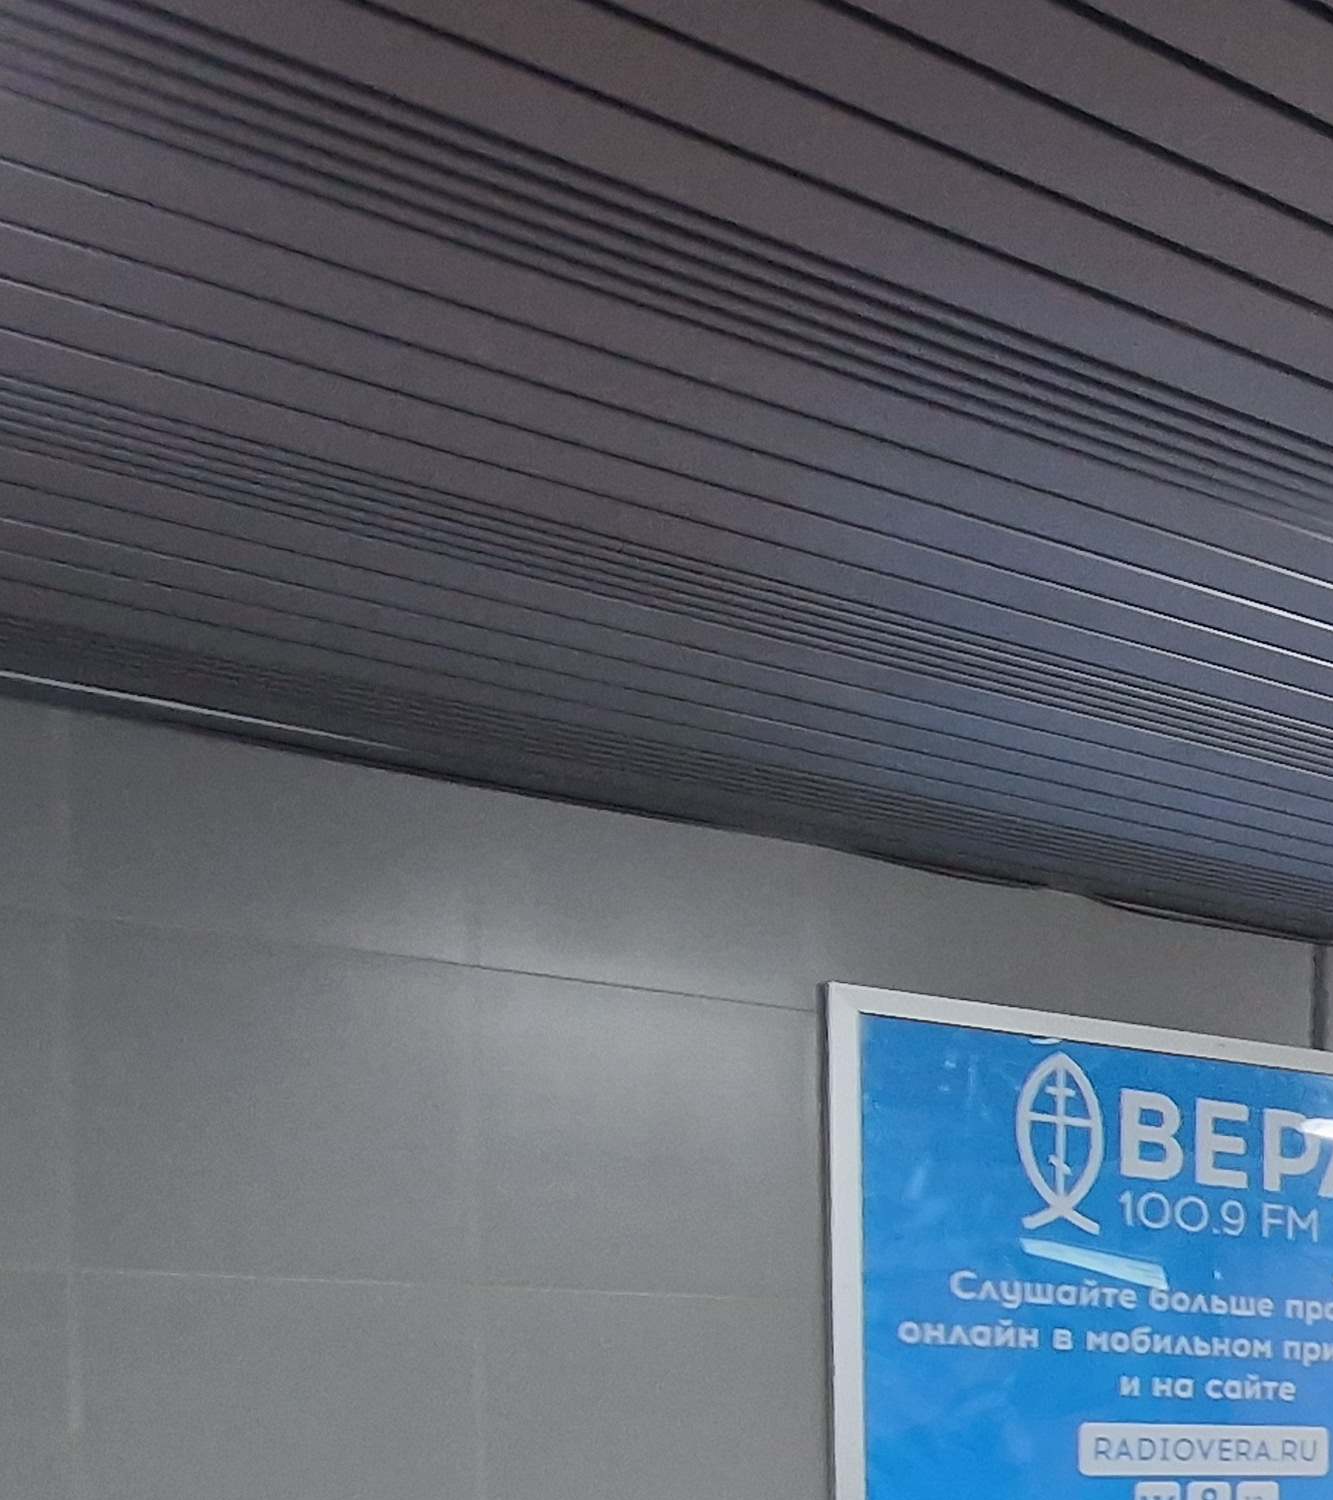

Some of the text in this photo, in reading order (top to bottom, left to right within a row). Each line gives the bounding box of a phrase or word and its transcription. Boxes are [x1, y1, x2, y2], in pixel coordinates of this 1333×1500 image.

[1119, 1190, 1319, 1242] 100.9 FM
[949, 1271, 1137, 1310] Слушайте
[1149, 1287, 1275, 1319] больше
[897, 1319, 1040, 1349] онлайн
[1052, 1328, 1074, 1350] в
[1085, 1326, 1272, 1360] мобильном
[1119, 1374, 1297, 1401] и на сайте
[1094, 1437, 1318, 1462] RADIOVERA.RU
